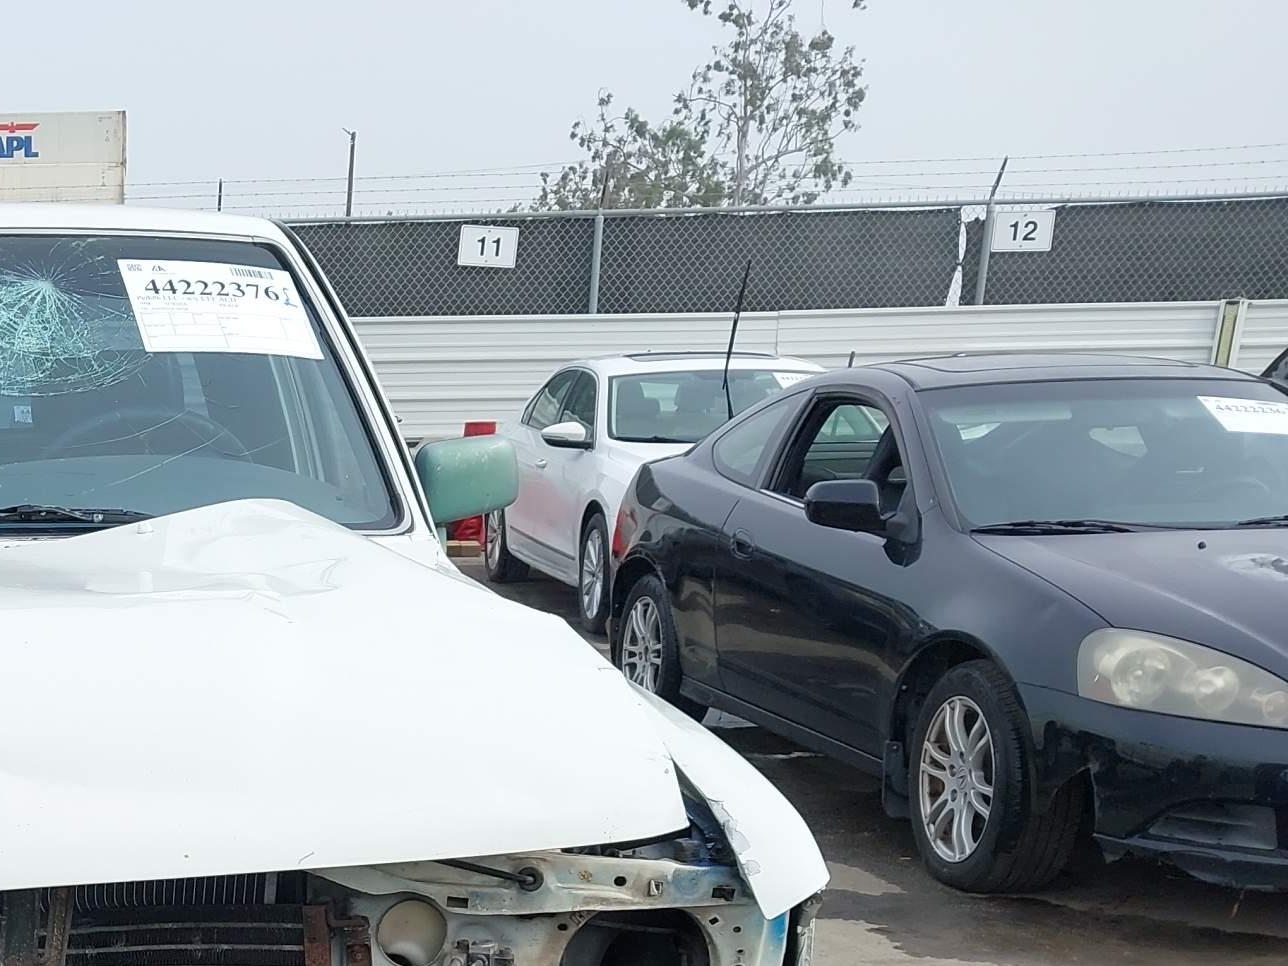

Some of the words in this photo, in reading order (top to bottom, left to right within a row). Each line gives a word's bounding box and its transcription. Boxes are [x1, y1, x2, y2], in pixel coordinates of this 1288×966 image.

[1009, 220, 1039, 241] 12
[477, 236, 502, 257] 11
[144, 278, 281, 301] 44222376
